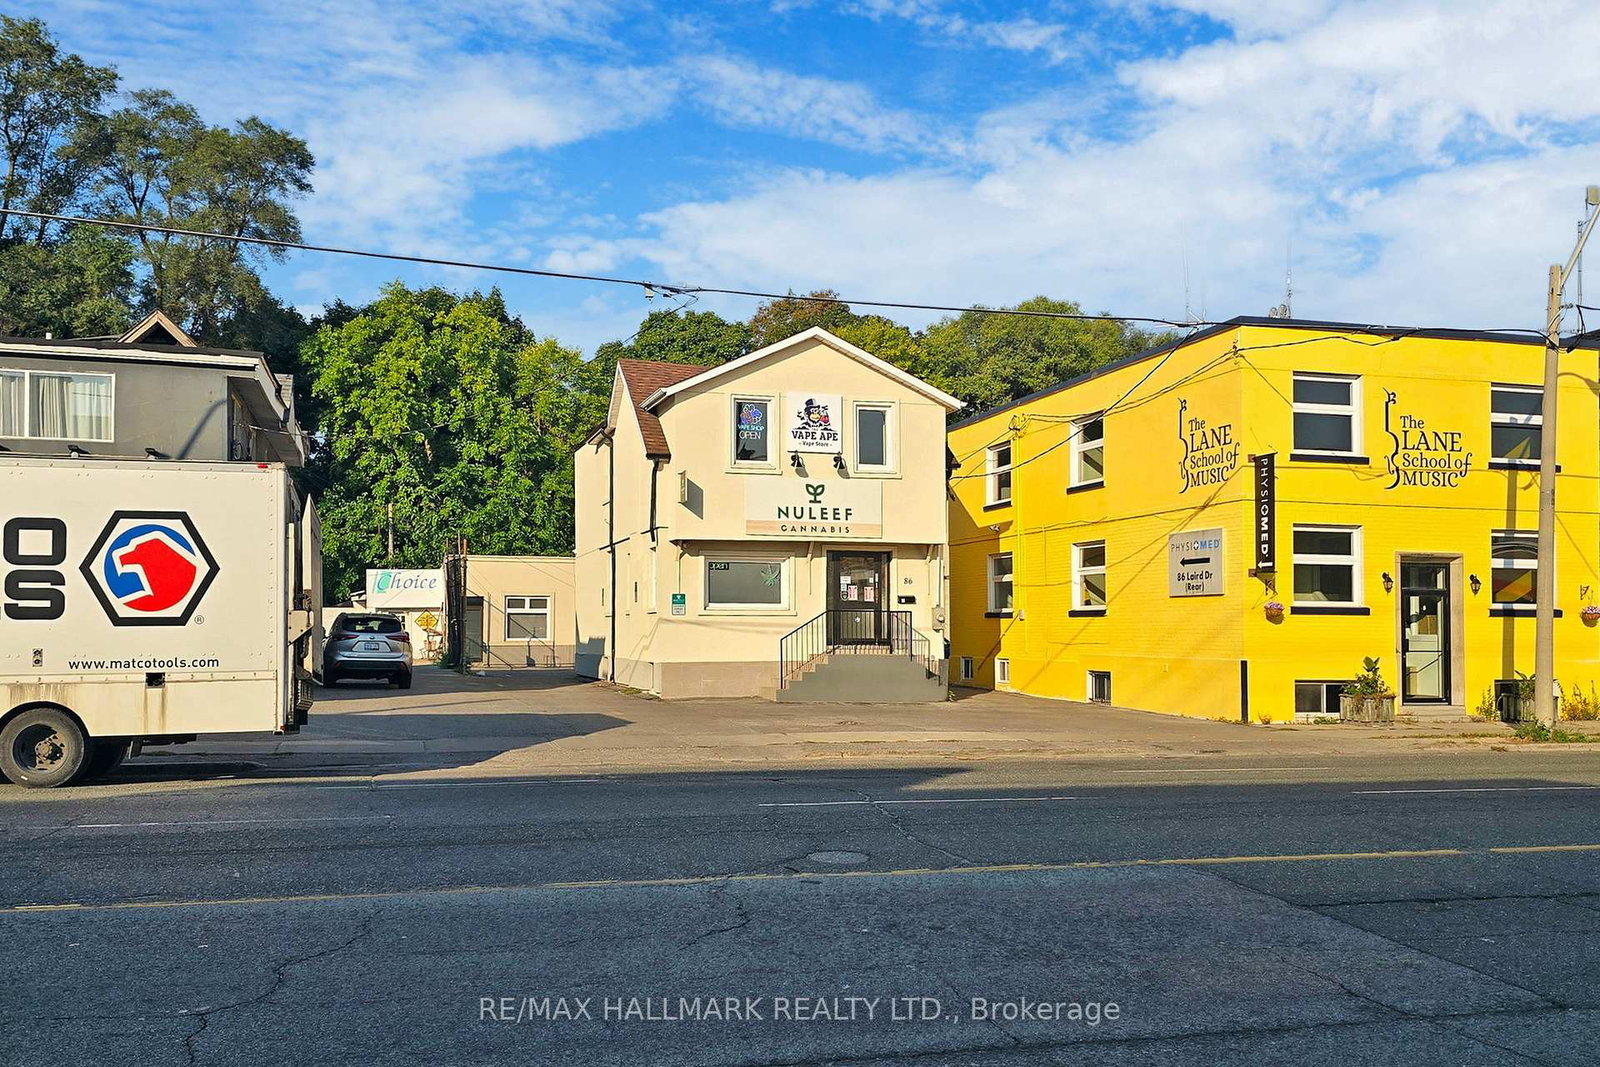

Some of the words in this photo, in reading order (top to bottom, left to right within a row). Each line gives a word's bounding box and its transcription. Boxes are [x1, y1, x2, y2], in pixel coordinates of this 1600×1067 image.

[1188, 417, 1206, 432] The
[1400, 415, 1424, 429] The
[739, 431, 761, 439] OPEN
[791, 430, 817, 440] VAPE
[819, 432, 838, 441] APE
[1190, 424, 1232, 453] LANE
[1402, 430, 1462, 452] LANE
[1190, 447, 1224, 470] School
[1226, 442, 1240, 470] of
[1402, 452, 1451, 468] School
[1455, 452, 1472, 478] of
[1190, 466, 1229, 487] MUSIC
[1402, 470, 1458, 488] MUSIC
[777, 507, 852, 521] NULEEF
[1260, 458, 1270, 556] PHYSIOMED
[781, 524, 850, 533] CANNABIS
[1171, 540, 1220, 552] PHYSIOMED
[375, 571, 437, 593] Choice
[903, 577, 913, 585] 86
[1177, 572, 1186, 581] 86
[1187, 571, 1204, 580] Laird
[1205, 571, 1213, 579] Dr
[1185, 582, 1205, 592] (Rear)
[68, 656, 219, 670] www.matcotools.com
